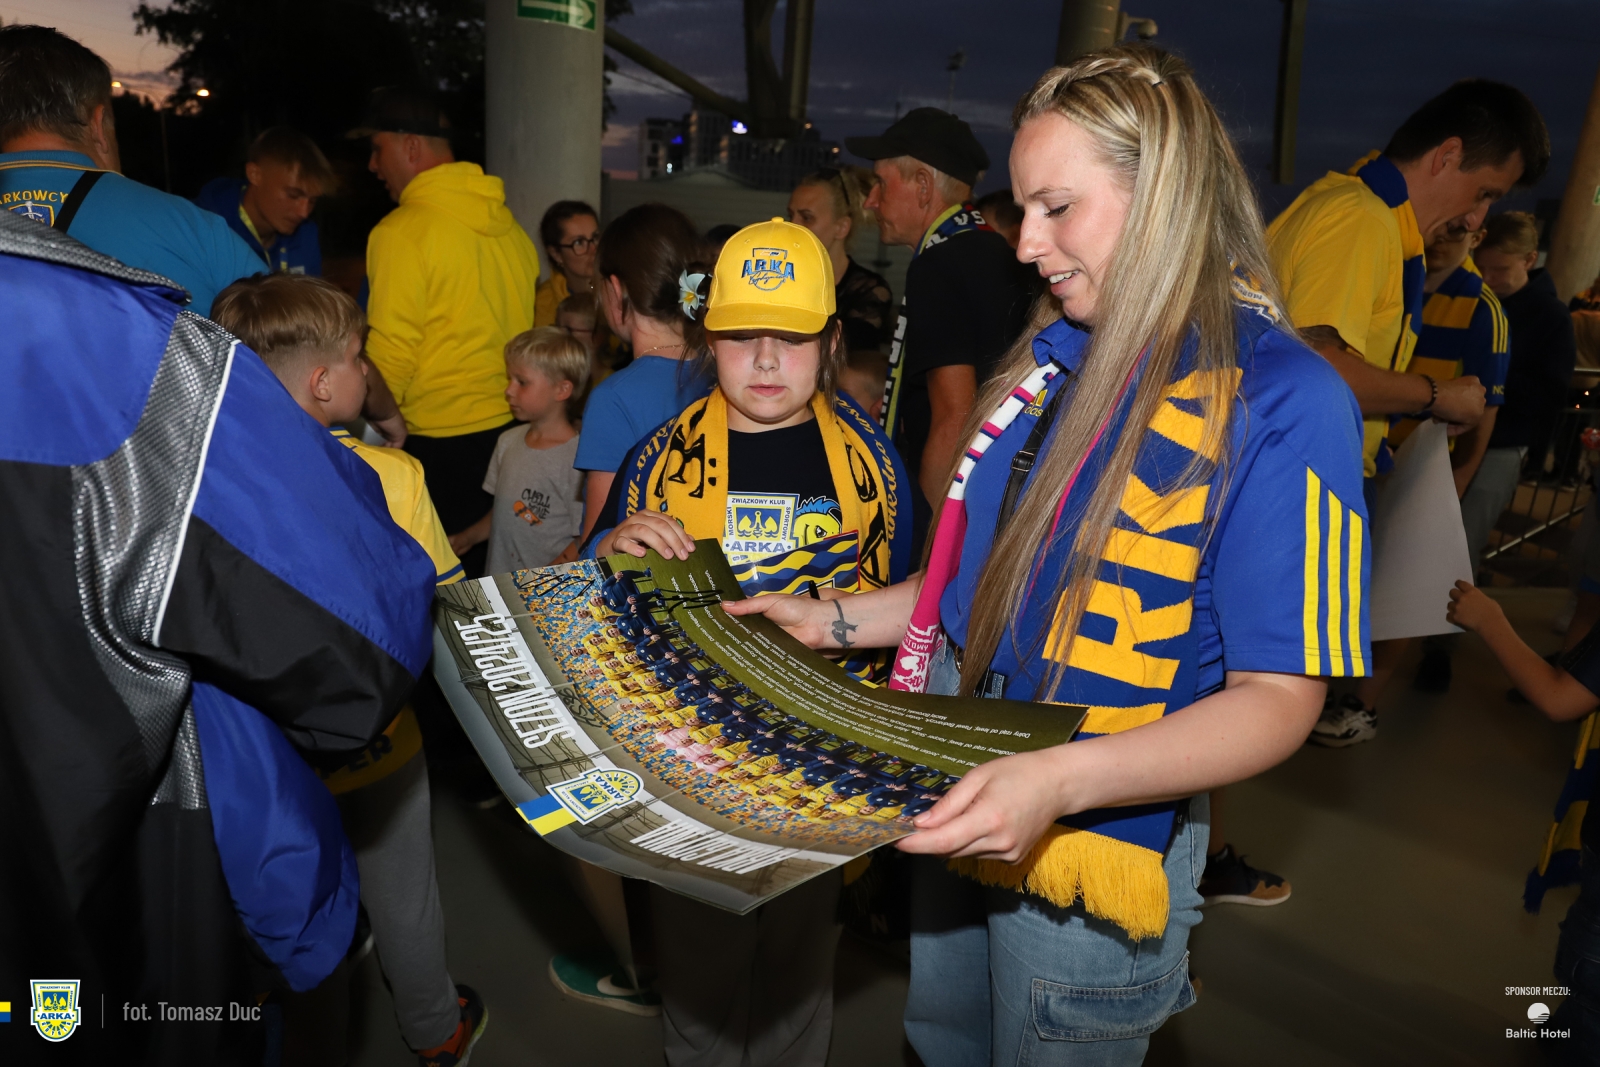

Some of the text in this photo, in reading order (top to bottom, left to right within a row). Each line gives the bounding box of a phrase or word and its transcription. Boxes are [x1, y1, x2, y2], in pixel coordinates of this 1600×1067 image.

[0, 190, 68, 204] RKOWCY
[741, 259, 795, 282] ARKA
[782, 506, 791, 540] SPORTOWY
[730, 541, 786, 552] ARKA
[494, 686, 576, 748] SEZON
[595, 776, 624, 799] ARKA
